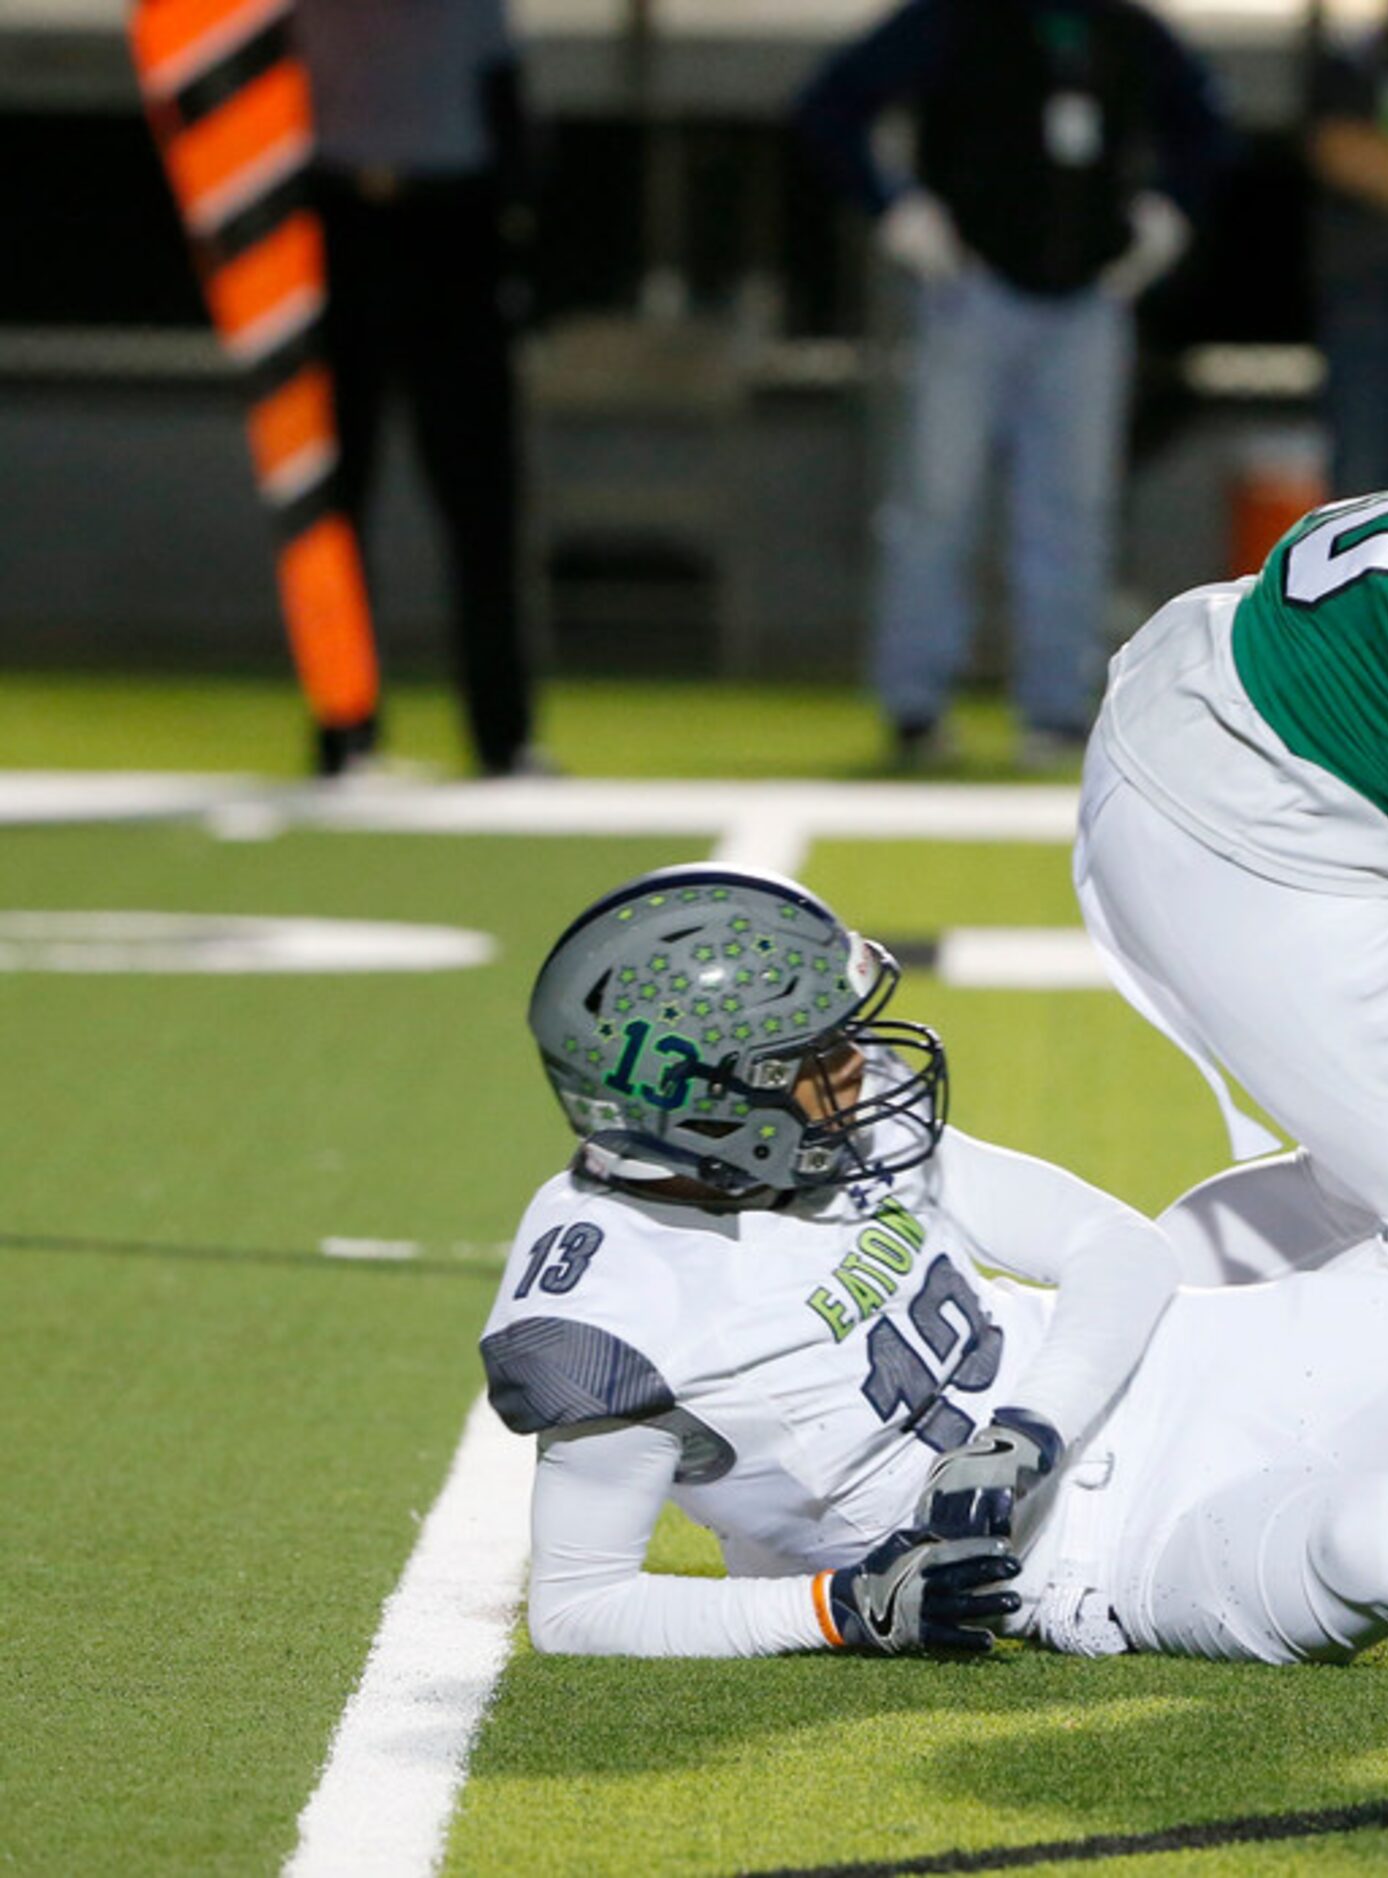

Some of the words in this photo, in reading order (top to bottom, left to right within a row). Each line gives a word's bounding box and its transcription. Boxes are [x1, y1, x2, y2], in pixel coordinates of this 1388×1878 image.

[602, 1018, 702, 1111] 13
[514, 1221, 606, 1300] 13
[808, 1195, 927, 1343] EATON
